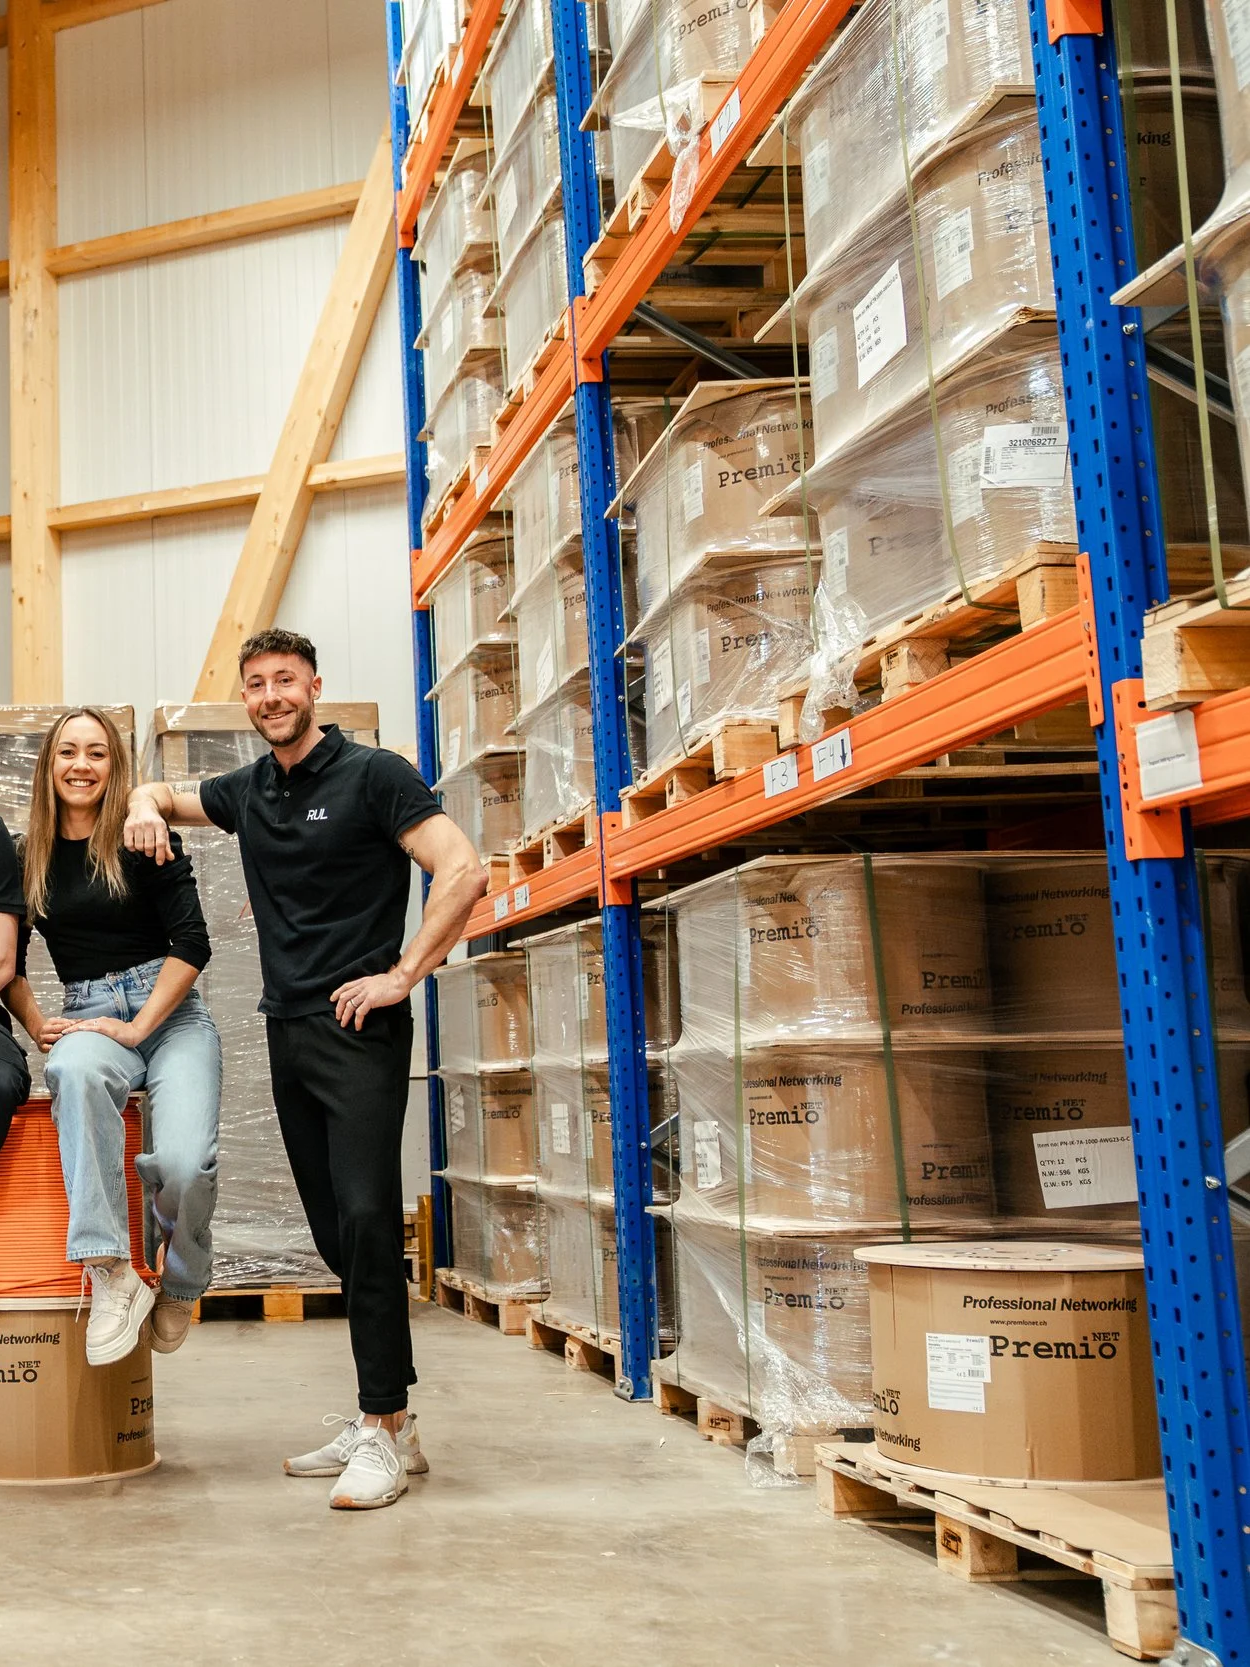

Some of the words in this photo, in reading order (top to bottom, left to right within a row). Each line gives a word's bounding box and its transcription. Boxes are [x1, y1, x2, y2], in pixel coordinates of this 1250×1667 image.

[985, 394, 1032, 416] Profess
[1008, 437, 1058, 447] 3210069277
[816, 743, 835, 771] F4
[770, 762, 788, 793] F3
[306, 808, 328, 821] RUL
[1041, 886, 1110, 900] Networking
[750, 921, 819, 944] Premio
[779, 1074, 842, 1087] Networking
[1063, 1099, 1086, 1107] NET
[749, 1106, 819, 1125] Premio
[800, 1102, 823, 1110] NET
[764, 1287, 845, 1310] Premio
[963, 1296, 1057, 1311] Professional
[1061, 1297, 1137, 1312] Networking
[990, 1335, 1116, 1359] Premio
[1092, 1332, 1120, 1341] NET
[18, 1360, 41, 1368] NET
[886, 1388, 900, 1399] NET
[130, 1397, 153, 1416] Pre
